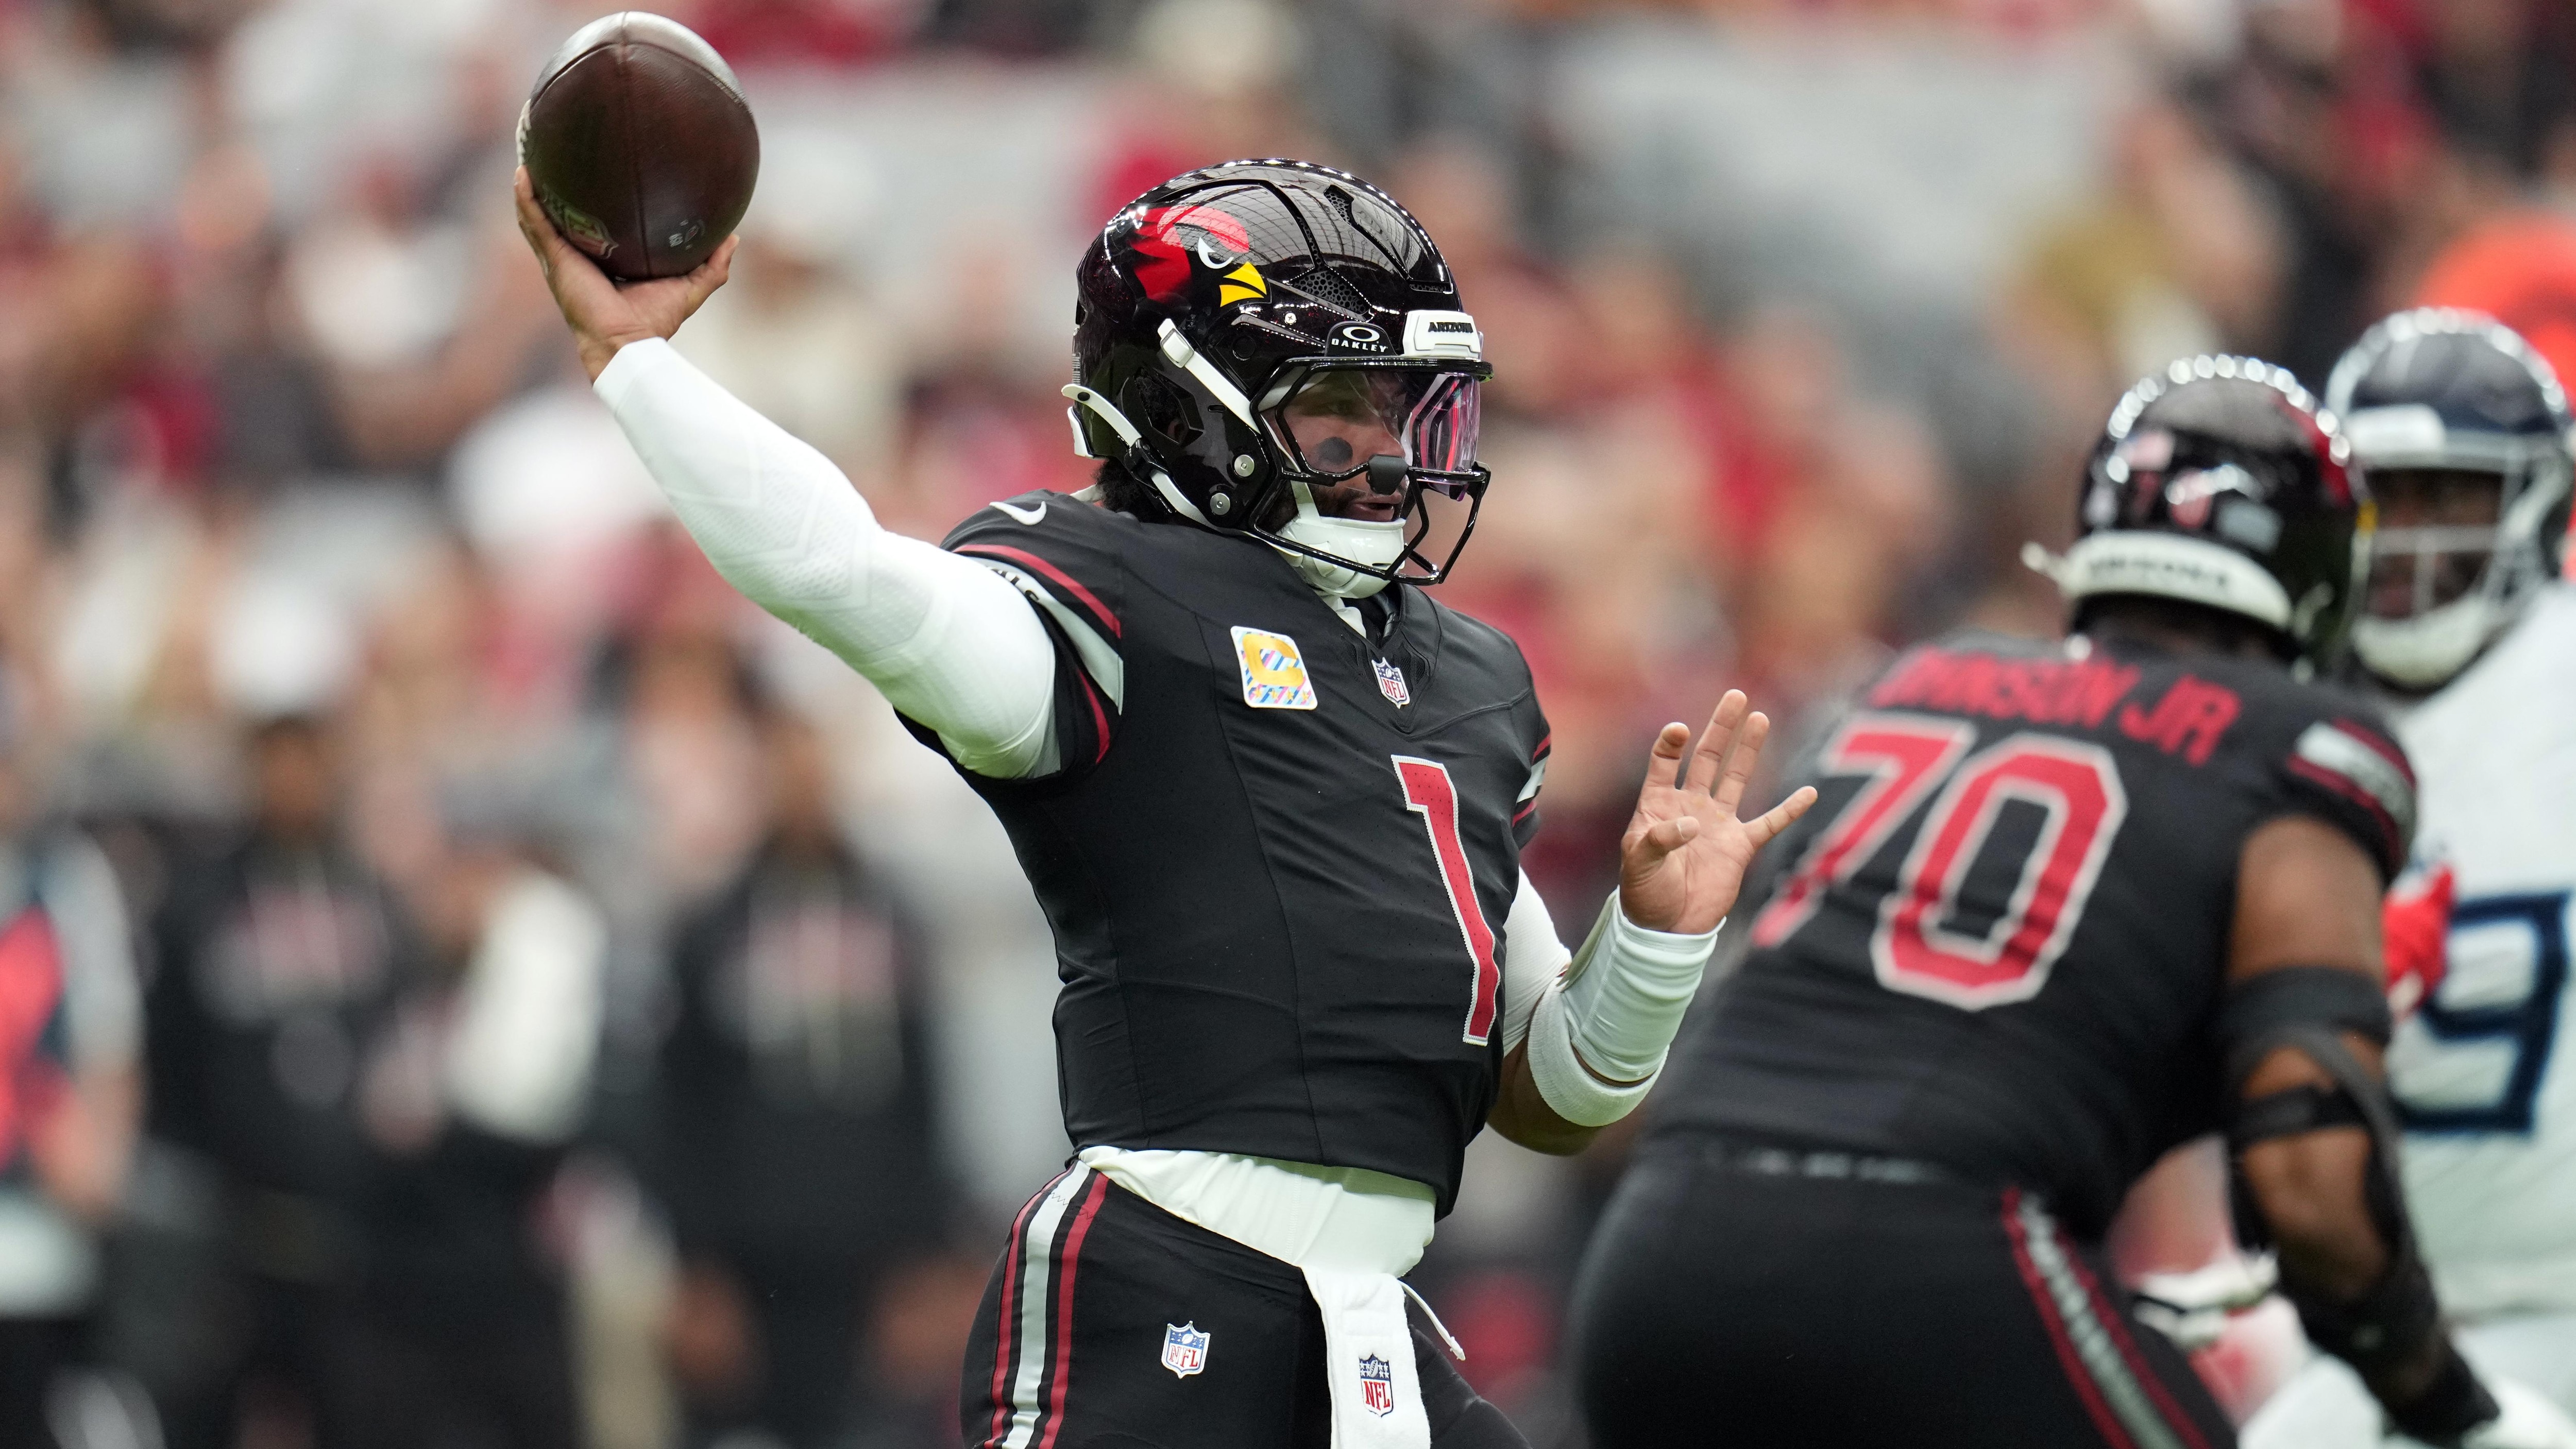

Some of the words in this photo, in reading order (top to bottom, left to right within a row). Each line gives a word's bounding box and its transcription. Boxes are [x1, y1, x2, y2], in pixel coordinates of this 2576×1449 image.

[1331, 338, 1387, 352] OAKLEY
[1242, 634, 1303, 687] C
[1383, 679, 1404, 699] NFL
[2119, 674, 2241, 766] JR
[1752, 710, 2128, 1011] 70
[1391, 754, 1500, 1046] 1
[1169, 1345, 1198, 1368] NFL
[1363, 1380, 1391, 1410] NFL
